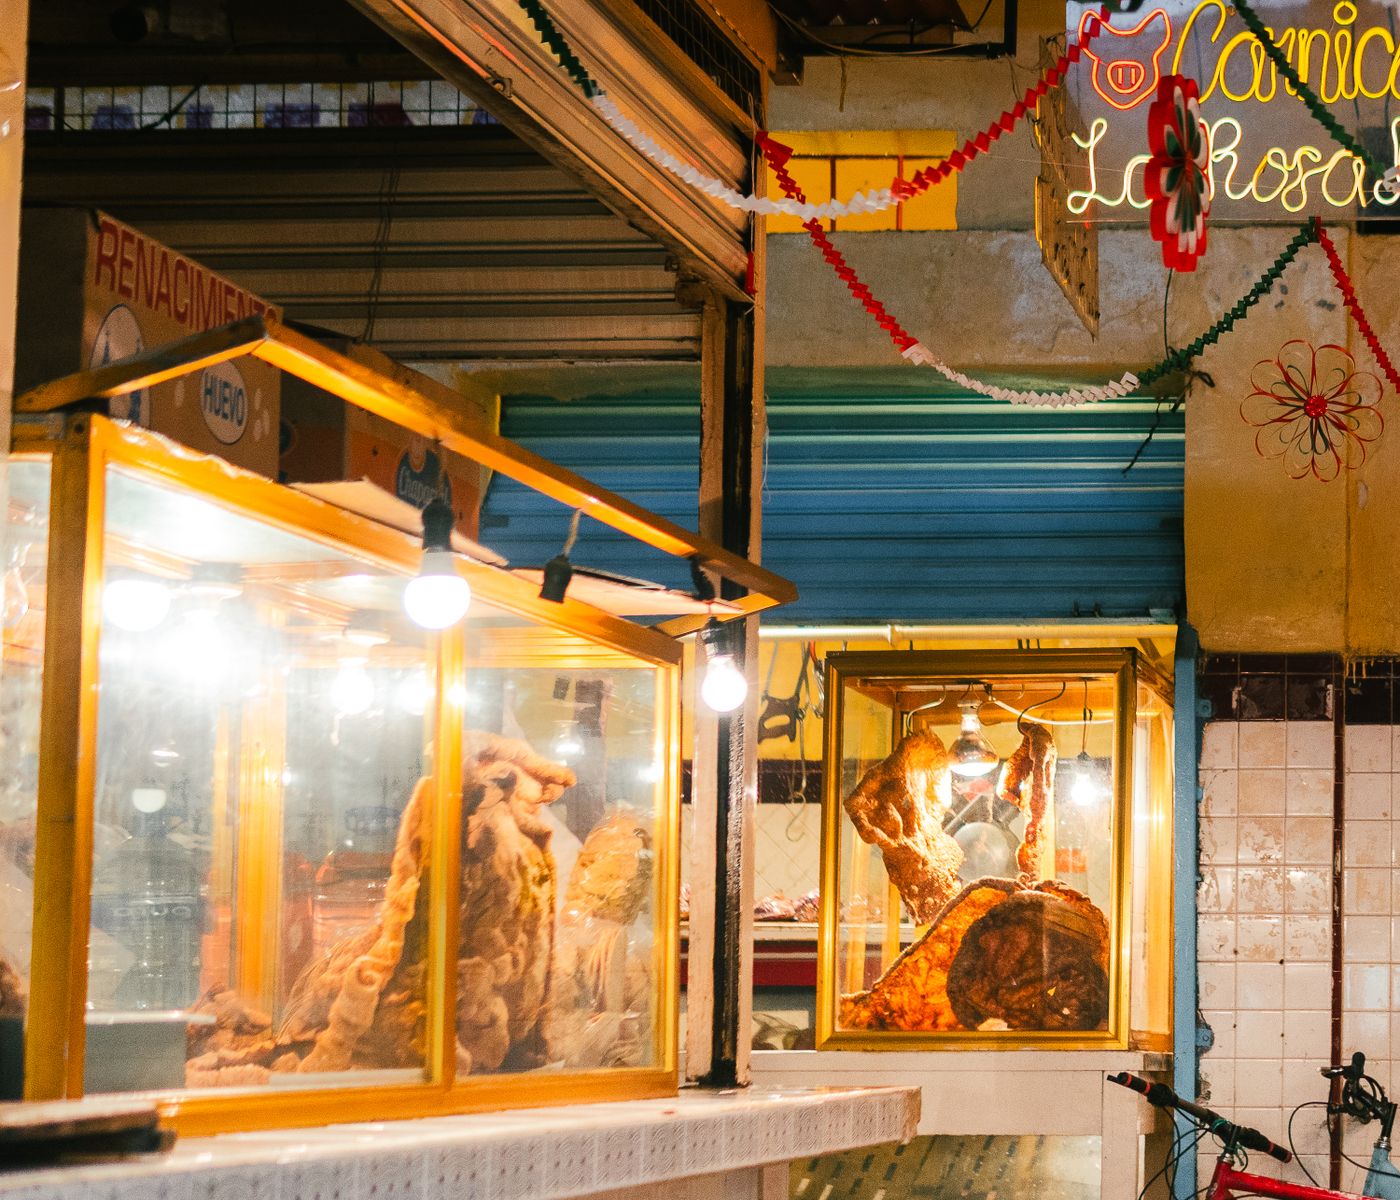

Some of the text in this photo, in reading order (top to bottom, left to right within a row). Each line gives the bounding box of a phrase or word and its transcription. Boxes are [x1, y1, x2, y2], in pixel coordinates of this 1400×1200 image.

[1067, 118, 1154, 214] La
[1199, 117, 1368, 213] Rosa
[95, 218, 277, 333] RENACIMIEN
[203, 372, 246, 427] HUEVO
